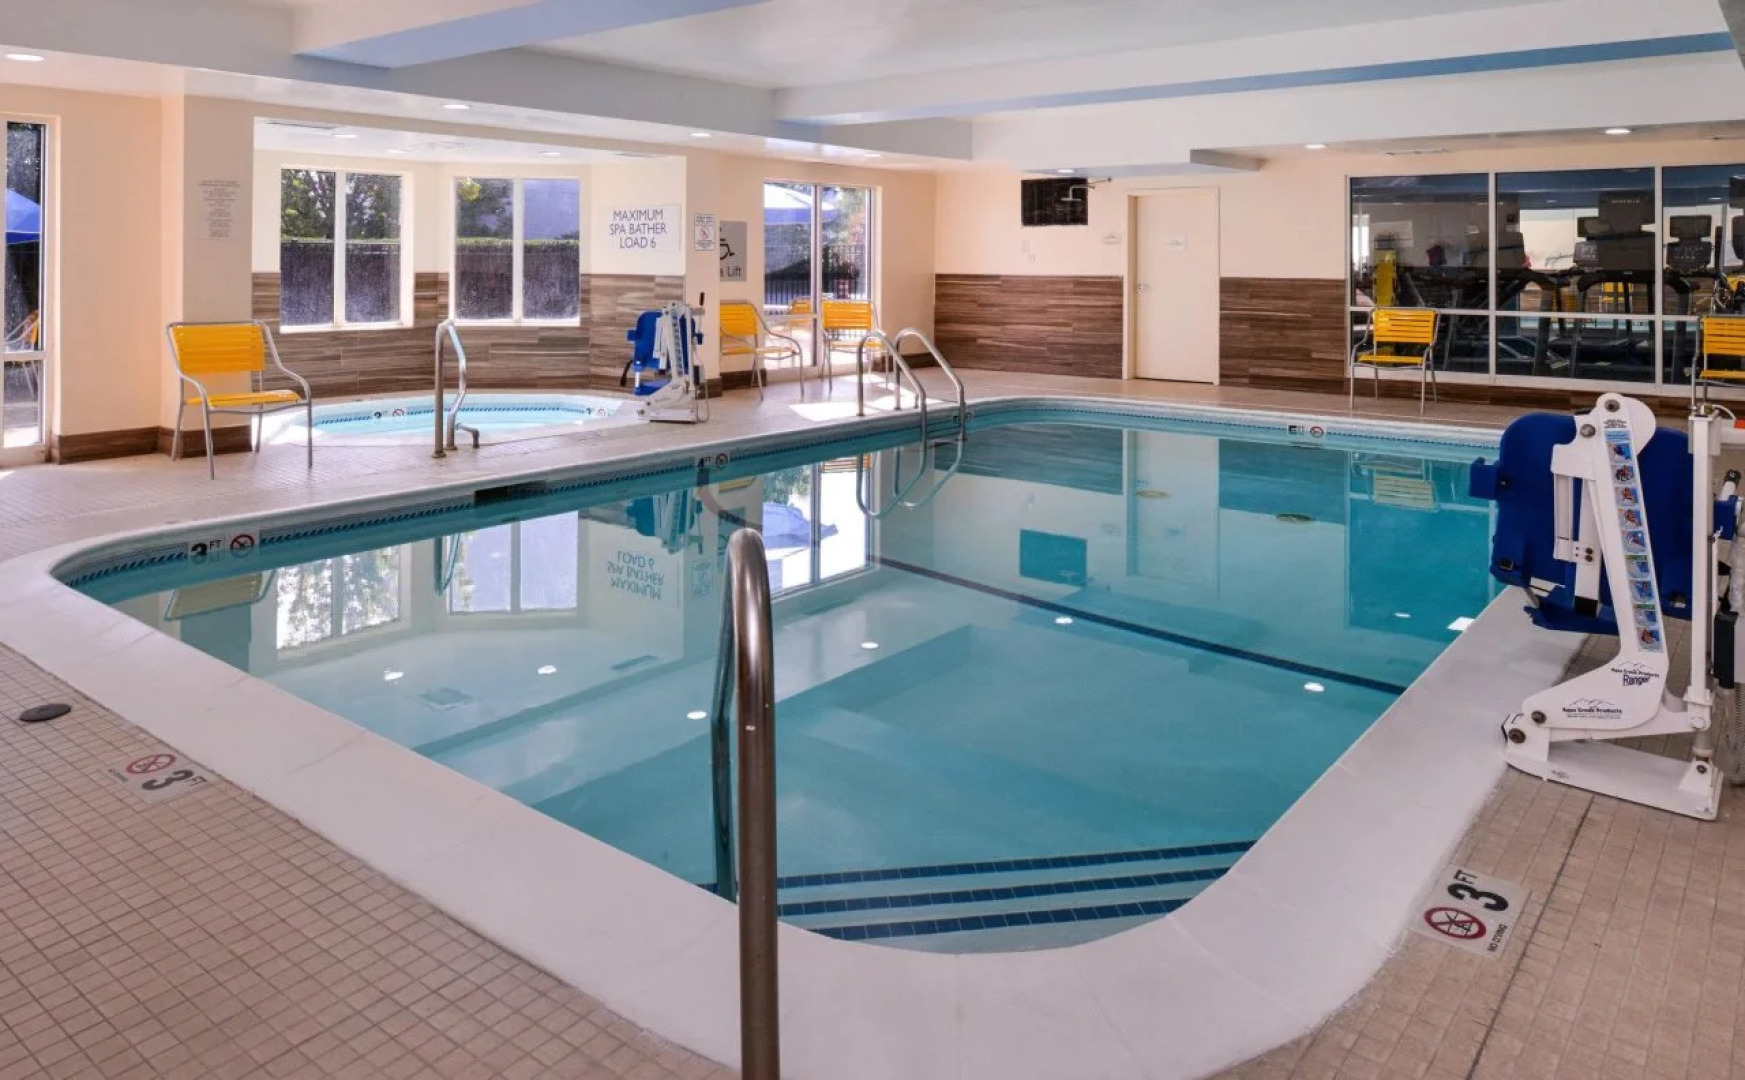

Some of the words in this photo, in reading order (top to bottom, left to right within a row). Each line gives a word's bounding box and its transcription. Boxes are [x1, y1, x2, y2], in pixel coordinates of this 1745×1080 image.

[613, 209, 664, 221] MAXIMUM
[609, 223, 626, 235] SPA
[629, 222, 667, 235] BATHER
[619, 236, 649, 249] LOAD
[650, 236, 657, 248] 6
[727, 265, 741, 277] Lift
[210, 540, 222, 550] FT
[1623, 674, 1650, 686] Ranger
[141, 769, 195, 791] 3
[1453, 869, 1478, 885] FT
[1447, 882, 1509, 912] 3
